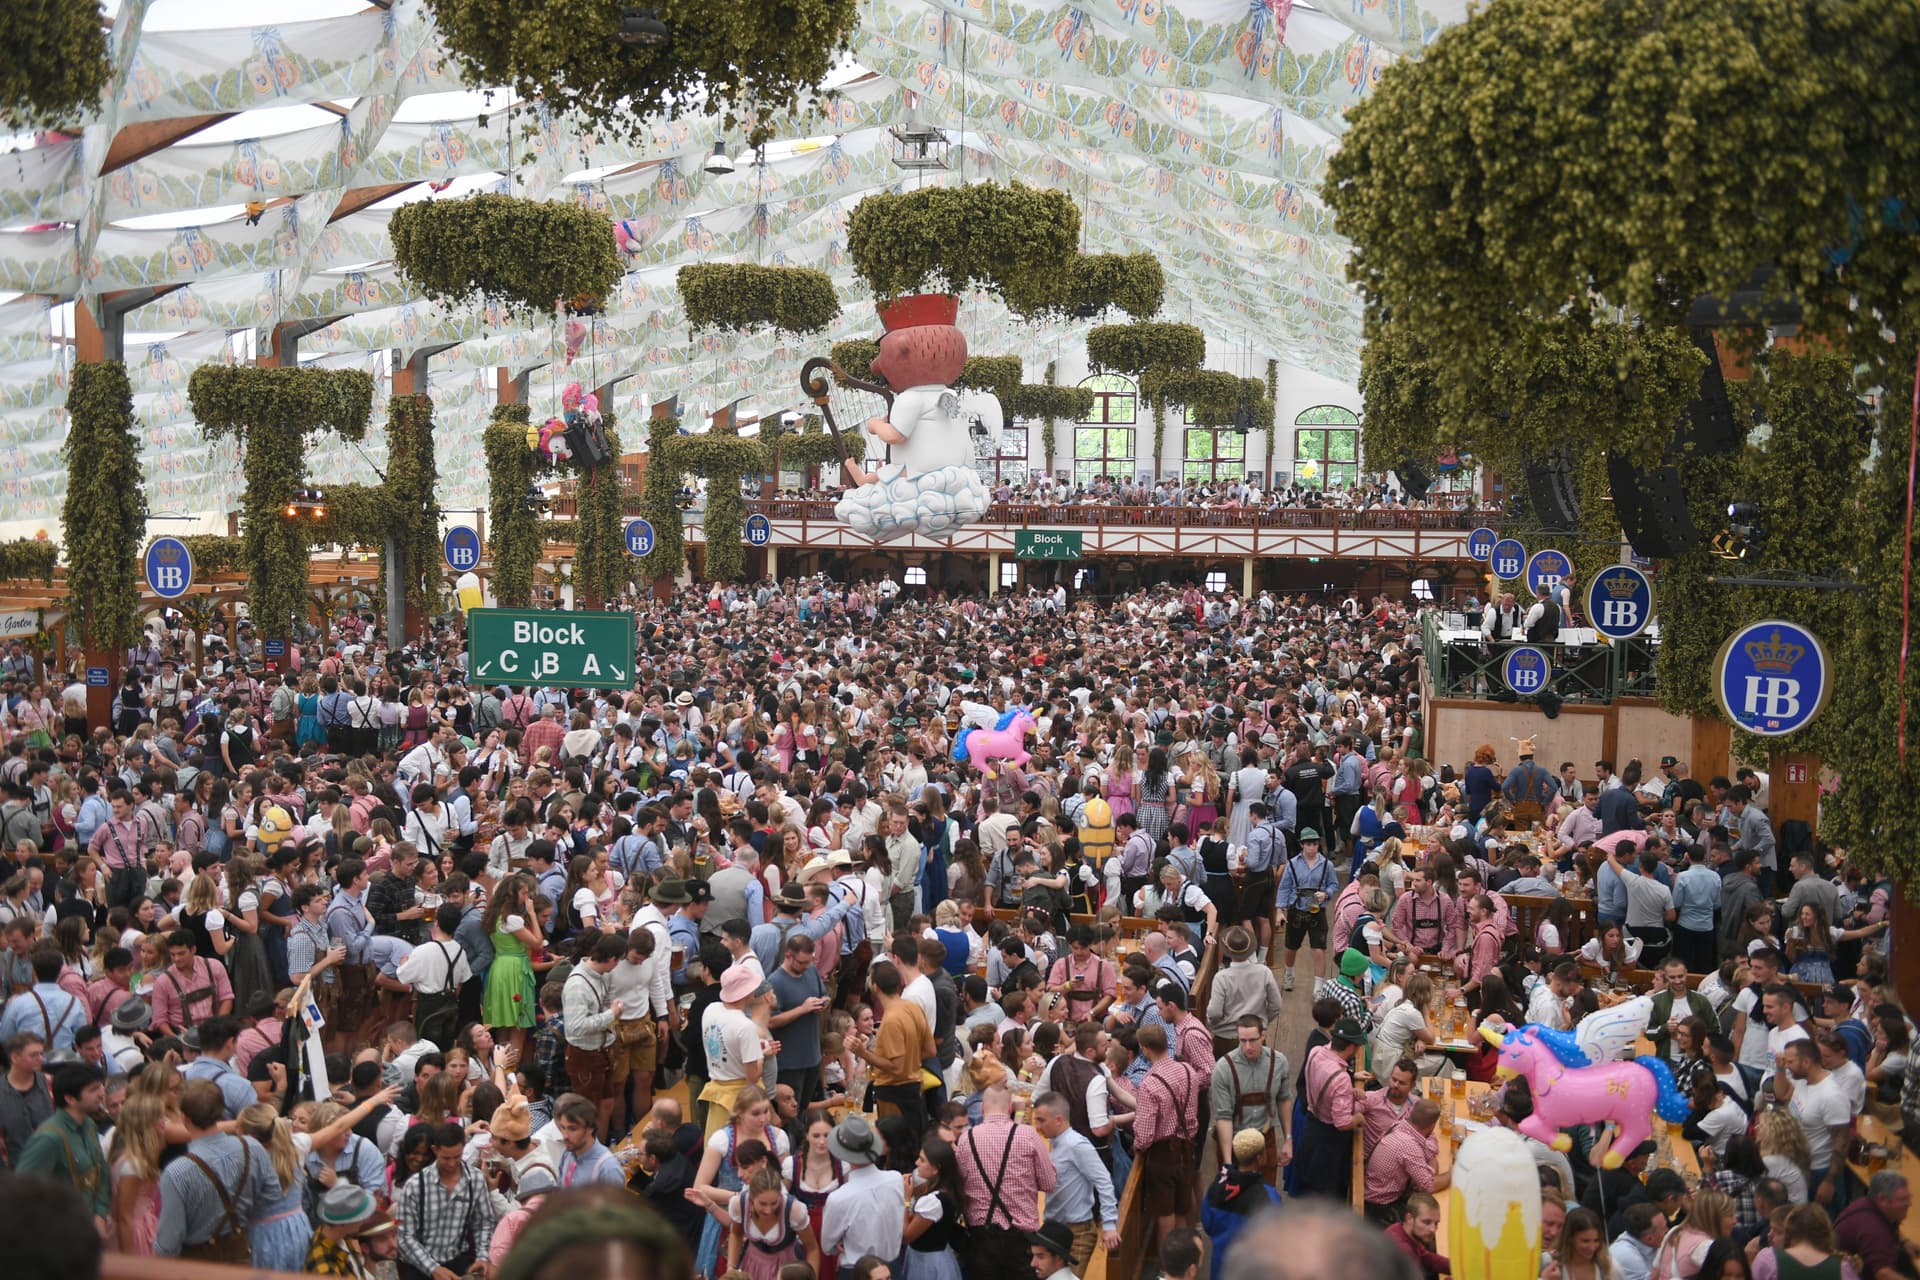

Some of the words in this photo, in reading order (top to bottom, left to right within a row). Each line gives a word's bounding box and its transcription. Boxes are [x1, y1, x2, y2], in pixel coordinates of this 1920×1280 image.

[632, 537, 649, 551] HB
[751, 529, 766, 541] HB
[1034, 534, 1063, 544] Block
[452, 547, 474, 565] HB
[1027, 545, 1035, 555] K
[1048, 546, 1054, 555] J
[1066, 546, 1070, 556] I
[1474, 543, 1491, 557] HB
[1499, 558, 1519, 574] HB
[157, 566, 183, 589] HB
[1602, 600, 1638, 627] HB
[4, 616, 33, 634] Garten
[514, 620, 585, 645] Block
[499, 649, 519, 673] C
[542, 652, 560, 674] B
[582, 653, 601, 676] A
[1514, 669, 1538, 687] HB
[1744, 675, 1801, 718] HB
